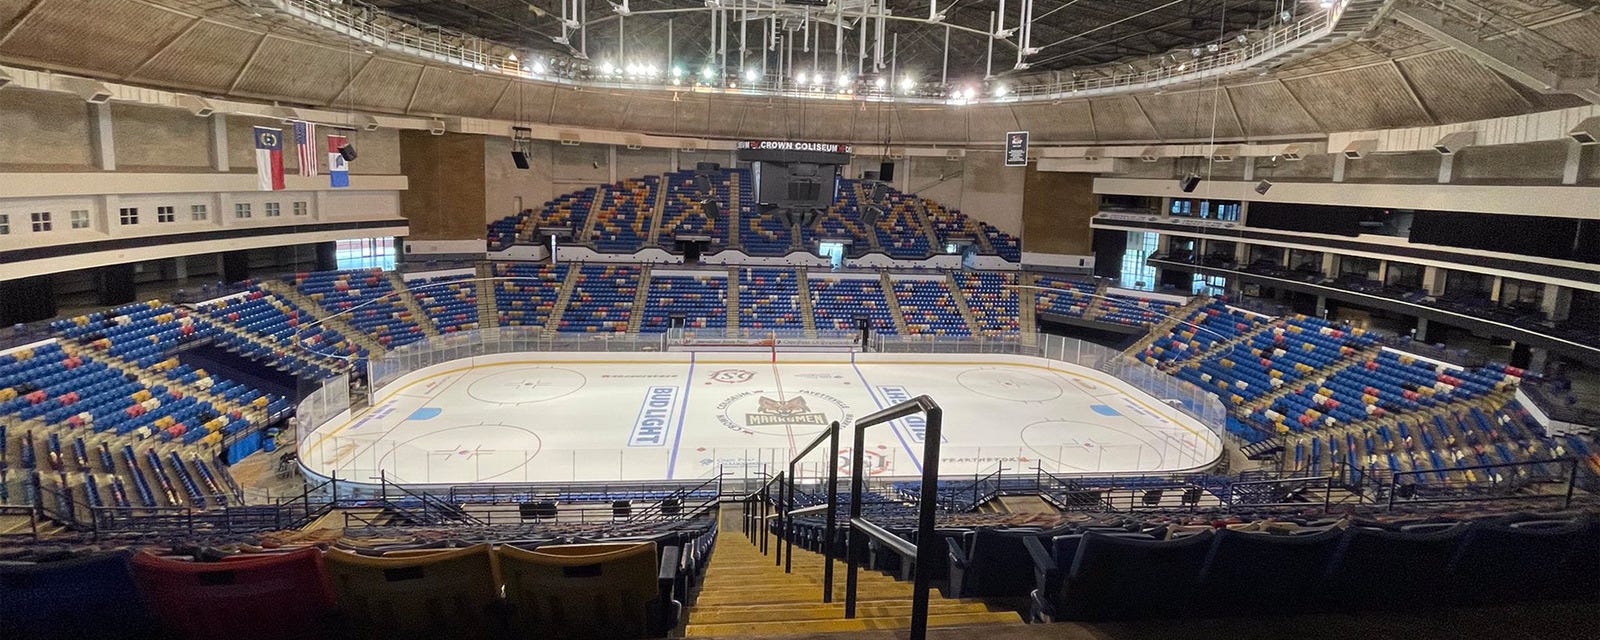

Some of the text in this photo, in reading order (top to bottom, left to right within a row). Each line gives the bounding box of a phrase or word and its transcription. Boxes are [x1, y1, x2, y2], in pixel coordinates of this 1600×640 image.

[760, 141, 793, 149] CROWN
[795, 142, 837, 152] COLISEUM
[636, 387, 673, 443] BUD LIGHT
[749, 415, 825, 424] MARKSMEN
